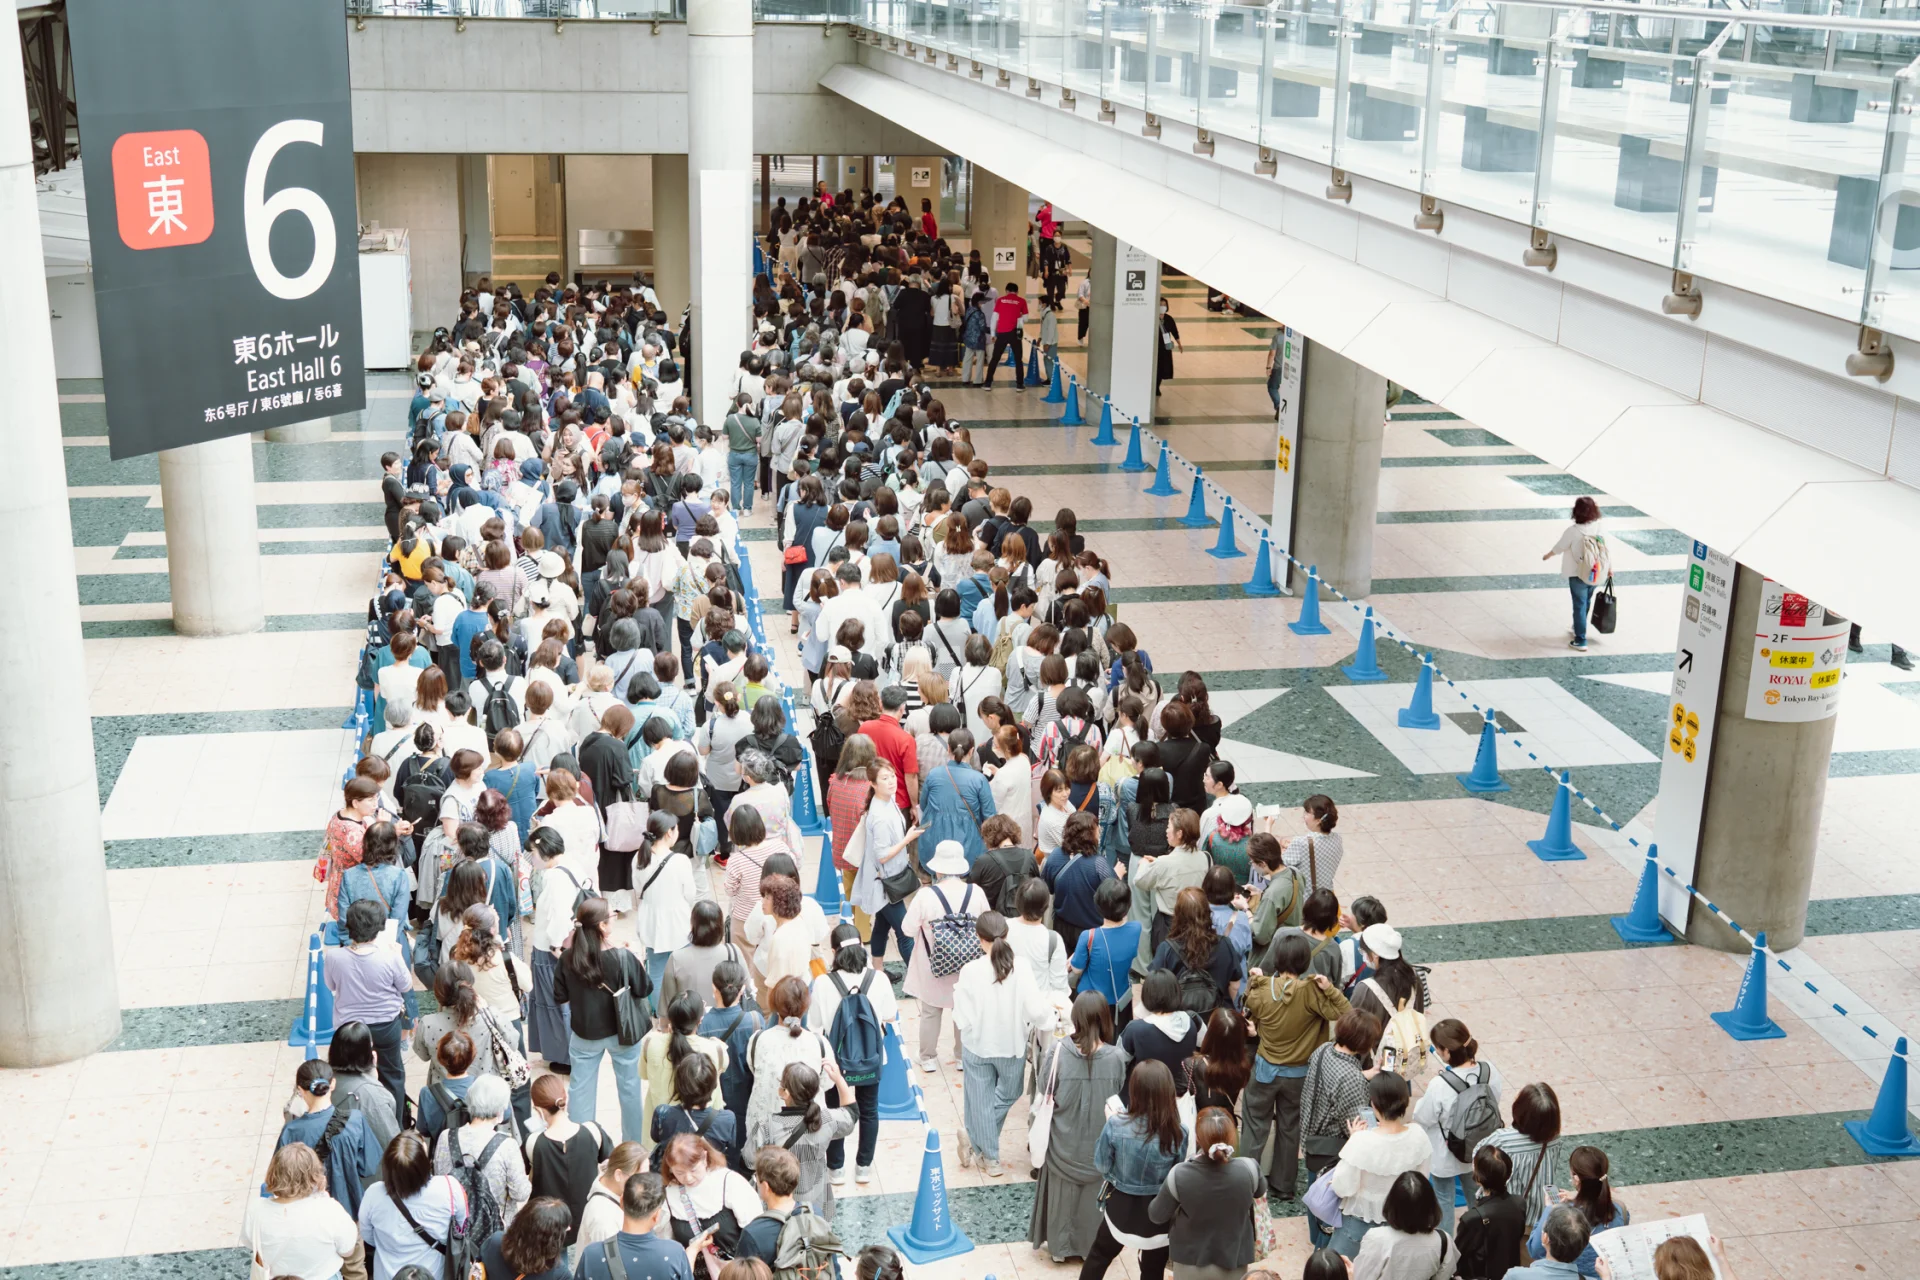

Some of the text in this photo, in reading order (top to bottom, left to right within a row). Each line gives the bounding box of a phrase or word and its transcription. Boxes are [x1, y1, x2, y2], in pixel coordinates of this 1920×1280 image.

[143, 146, 181, 167] East
[143, 174, 188, 235] 東
[244, 119, 336, 300] 6
[233, 323, 340, 365] 東6ホール
[247, 355, 342, 392] East Hall 6
[204, 401, 249, 422] 东6号厅
[1772, 633, 1788, 643] 2F
[1780, 656, 1807, 665] 休業中
[1769, 674, 1806, 685] ROYAL
[1818, 673, 1836, 685] 休業中
[1782, 695, 1806, 704] Tokyo
[845, 1072, 876, 1082] adidas
[930, 1167, 942, 1231] 東京ビッグサイト
